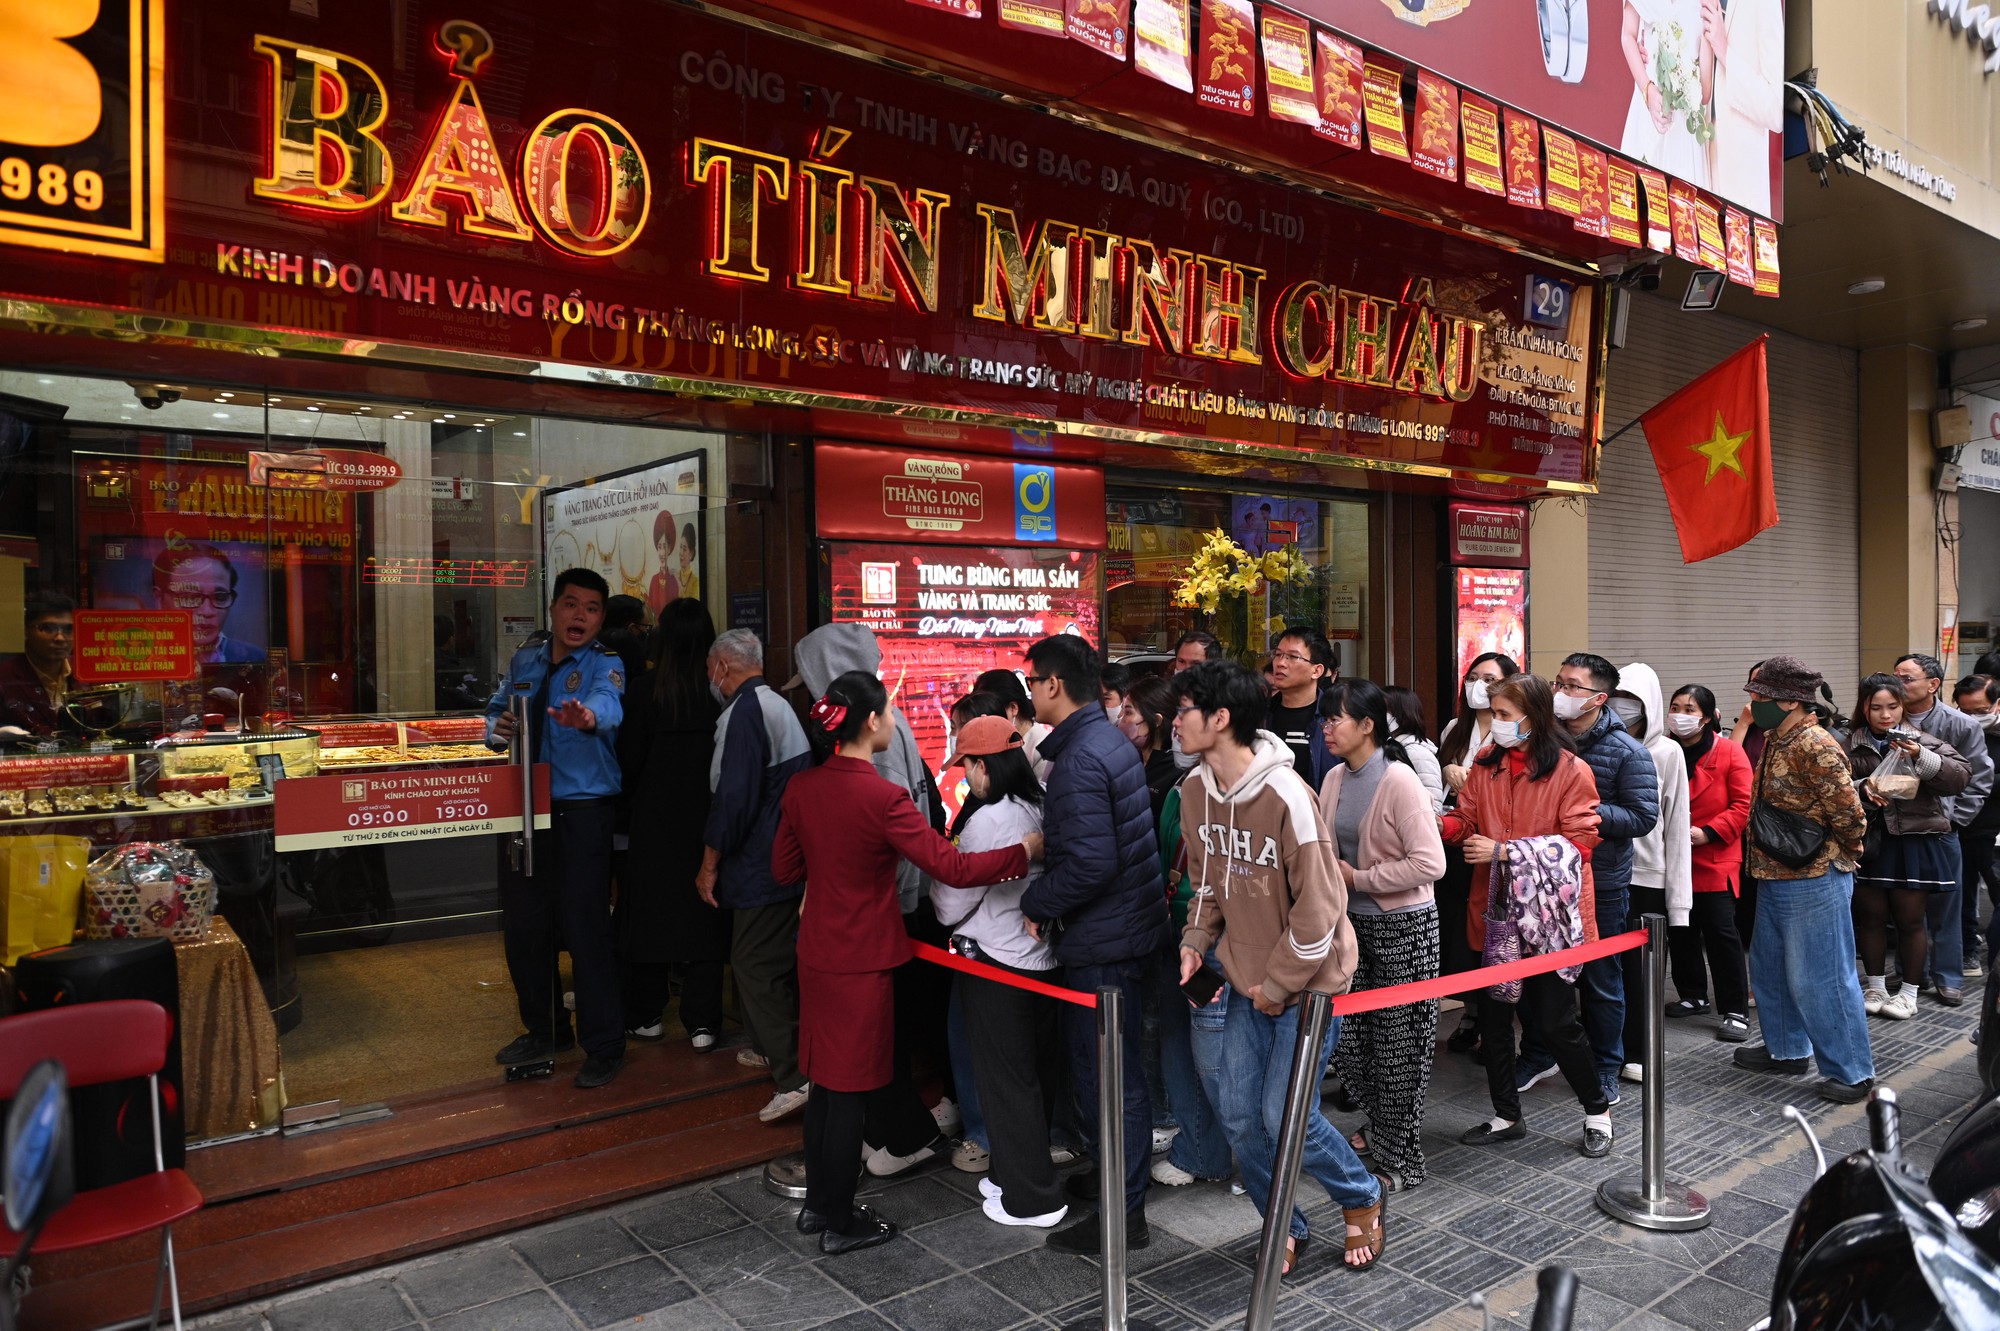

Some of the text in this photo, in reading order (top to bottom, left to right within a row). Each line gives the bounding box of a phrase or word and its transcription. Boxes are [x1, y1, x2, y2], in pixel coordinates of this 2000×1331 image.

[1068, 24, 1111, 50] QUỐC TẾ
[1069, 14, 1112, 41] TIÊU CHUẨN
[1200, 94, 1240, 109] QUỐC TẾ
[1201, 84, 1241, 99] TIÊU CHUẨN
[680, 50, 785, 103] CÔNG
[797, 81, 844, 118] TY
[855, 96, 937, 146] TNHH
[949, 121, 1028, 169] VÀNG
[1037, 147, 1092, 187] BẠC
[1101, 164, 1135, 198] ĐÁ
[1141, 177, 1193, 213] QUÝ
[1259, 208, 1305, 244] LTD)
[1872, 144, 1956, 201] 35 TRẦN NHÂN TÔNG
[254, 19, 1487, 402] BẢO TÍN MINH CHÂU
[1537, 283, 1564, 318] 29
[216, 243, 303, 286] KINH
[312, 257, 436, 305] DOANH
[446, 275, 533, 317] VÀNG
[542, 288, 625, 330] RỒNG
[633, 306, 724, 345] THĂNG
[731, 322, 807, 361] LONG,
[860, 338, 890, 369] VÀ
[896, 344, 954, 376] VÀNG
[957, 356, 1022, 387] TRANG
[1026, 363, 1062, 392] SỨC
[1064, 370, 1094, 396] MỸ
[1096, 377, 1142, 407] NGHỆ
[1145, 381, 1188, 408] CHẤT
[1190, 388, 1223, 415] LIỆU
[1226, 388, 1266, 419] BẰNG
[1269, 397, 1306, 425] VÀNG
[1306, 402, 1344, 429] RỒNG
[1346, 410, 1388, 435] THĂNG
[1389, 418, 1423, 439] LONG
[1495, 327, 1583, 362] TRẦN NHÂN TÔNG
[1529, 370, 1554, 389] HÀNG
[1554, 372, 1576, 393] VÀNG
[1510, 389, 1530, 407] TIÊN
[1530, 391, 1548, 410] CỦA
[1548, 398, 1571, 415] BTMC
[1981, 447, 2000, 467] CHÁ
[326, 460, 396, 477] ỨC 99.9-999.9
[908, 461, 960, 476] VÀNG RỒNG
[335, 478, 385, 488] GOLD JEWELRY
[563, 478, 669, 517] VÀNG TRANG SỨC CỦA HỒI MÔN
[886, 484, 980, 507] THĂNG LONG
[905, 504, 964, 516] FINE GOLD 999.9
[1476, 515, 1503, 524] BTMC 1989
[915, 520, 953, 529] BTMC 1989
[1020, 514, 1052, 535] SJC
[1459, 521, 1519, 541] HOÀNG KIM BẢO
[1465, 543, 1515, 554] PURE GOLD JEWELRY
[917, 564, 963, 586] TƯNG
[966, 561, 1011, 587] BỪNG
[1013, 568, 1046, 588] MUA
[1048, 562, 1080, 589] SẮM
[917, 588, 1052, 611] VÀNG VÀ TRANG SỨC
[862, 608, 896, 618] BẢO TÍN
[882, 619, 903, 631] CHÂU
[120, 661, 131, 671] XE
[370, 773, 492, 791] BẢO TÍN MINH CHÂU
[384, 785, 480, 800] KÍNH CHÀO QUÝ KHÁCH
[347, 809, 409, 827] 09:00
[436, 803, 489, 820] 19:00
[342, 821, 494, 842] TỪ THỨ 2 ĐẾN CHỦ NHẬT (CẢ NGÀY LỄ)
[1197, 823, 1280, 871] STHA
[1385, 933, 1415, 946] HUOBAN
